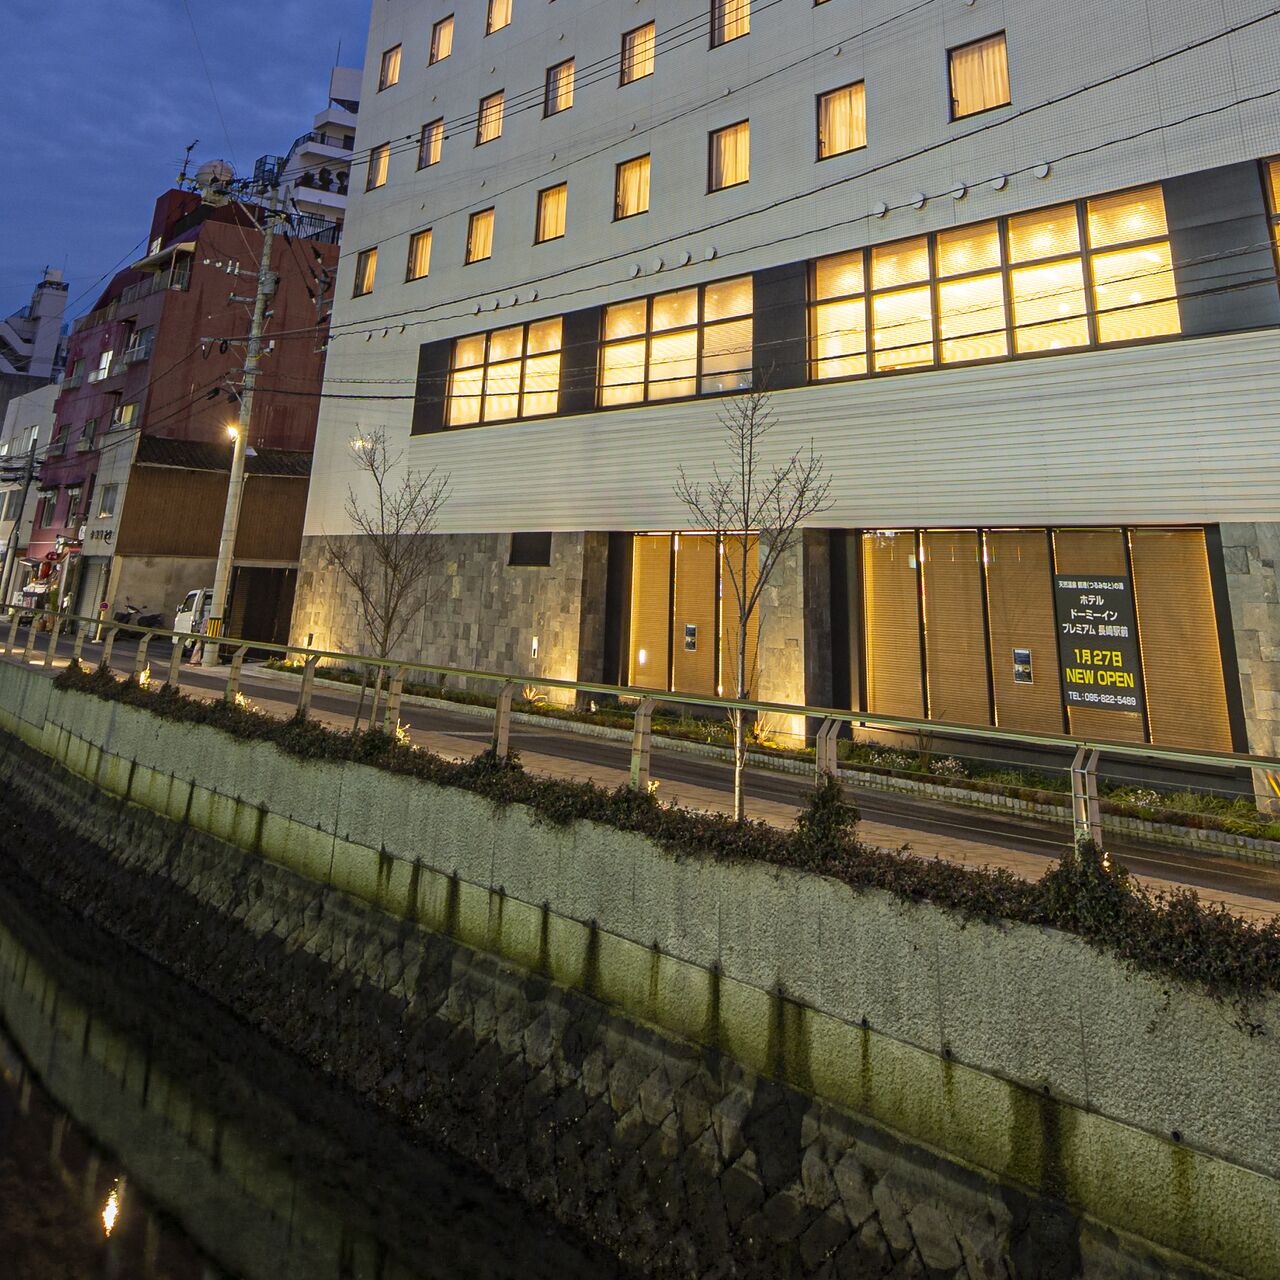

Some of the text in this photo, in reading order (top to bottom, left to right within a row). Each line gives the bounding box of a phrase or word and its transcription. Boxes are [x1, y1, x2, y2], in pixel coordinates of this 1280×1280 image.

[1080, 595, 1104, 605] ホテル
[1070, 609, 1118, 620] ドーミーイン
[1062, 623, 1128, 637] プレミアム 長崎駅前
[1066, 668, 1134, 687] NEW OPEN
